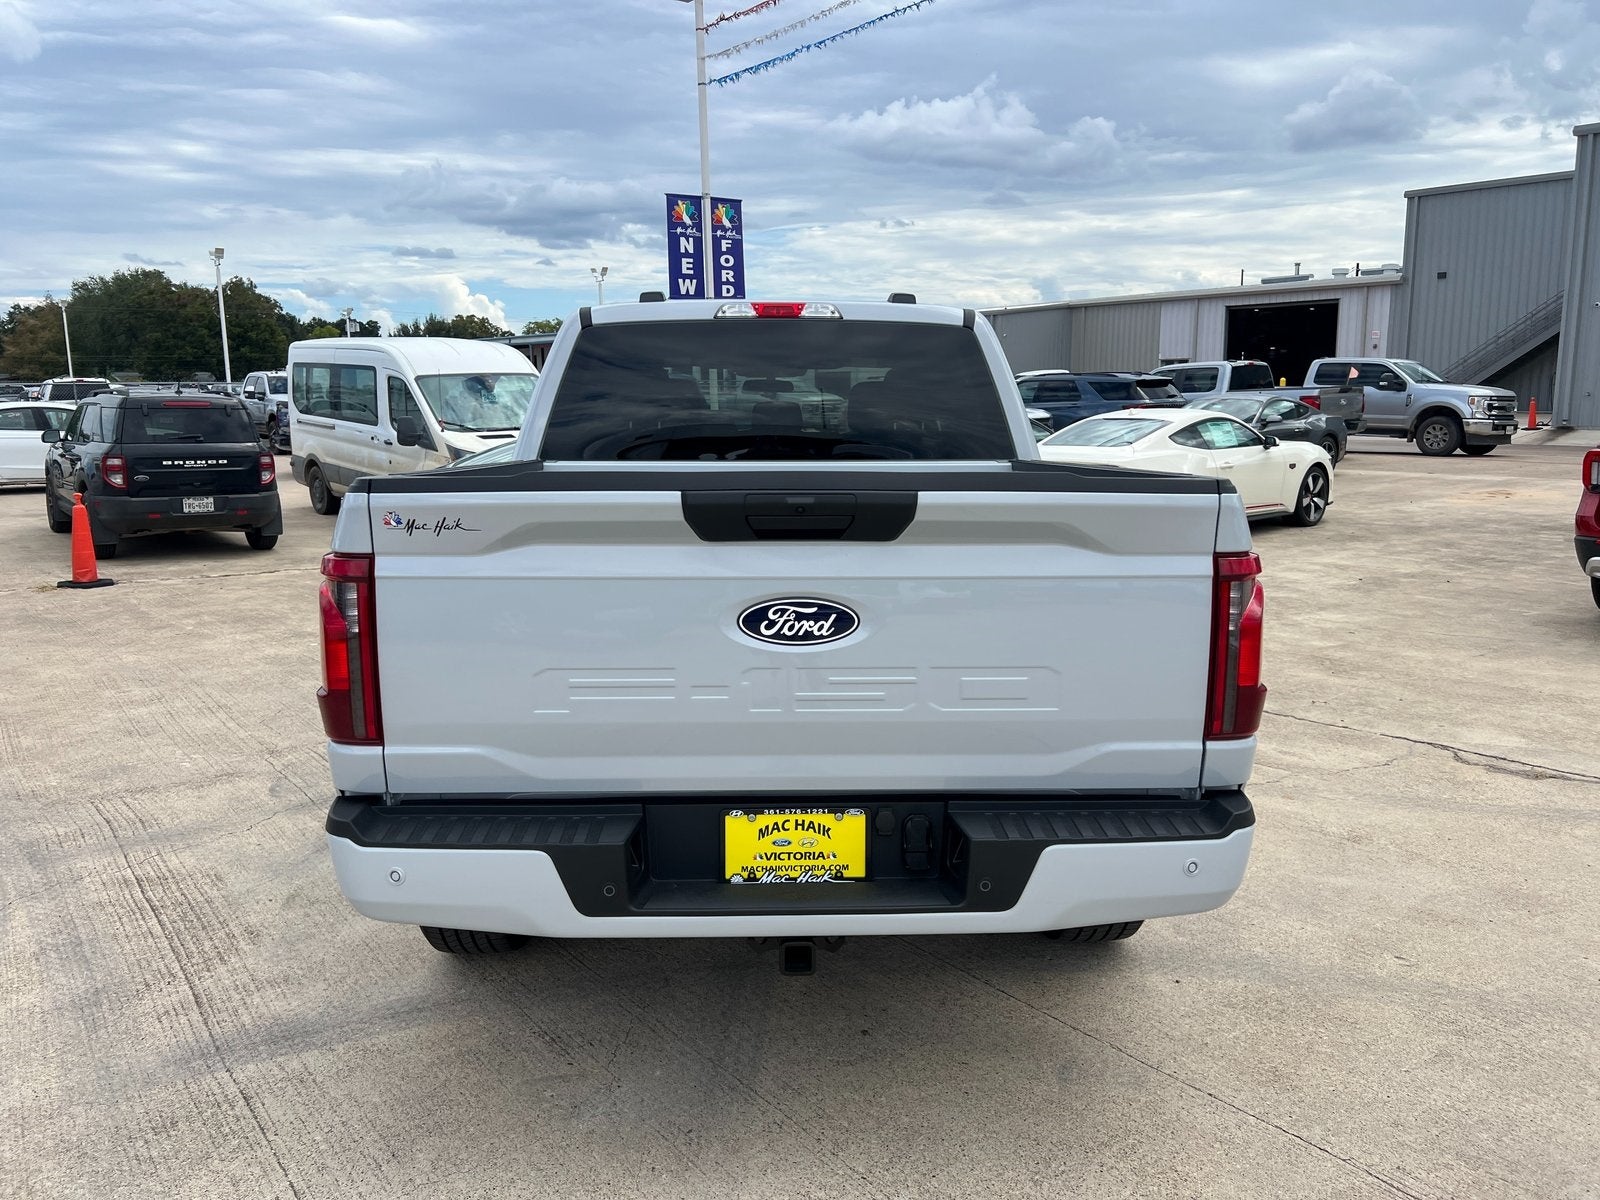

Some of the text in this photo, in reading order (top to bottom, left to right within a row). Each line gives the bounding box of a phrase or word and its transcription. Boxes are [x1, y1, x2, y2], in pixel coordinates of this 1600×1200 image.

[678, 237, 697, 295] NEW
[720, 240, 735, 297] FORD
[403, 516, 482, 537] Mac Haik
[760, 605, 837, 636] Ford
[758, 818, 832, 841] MAC HAIK
[764, 852, 826, 861] VICTORIA
[758, 870, 855, 883] Mac Haik
